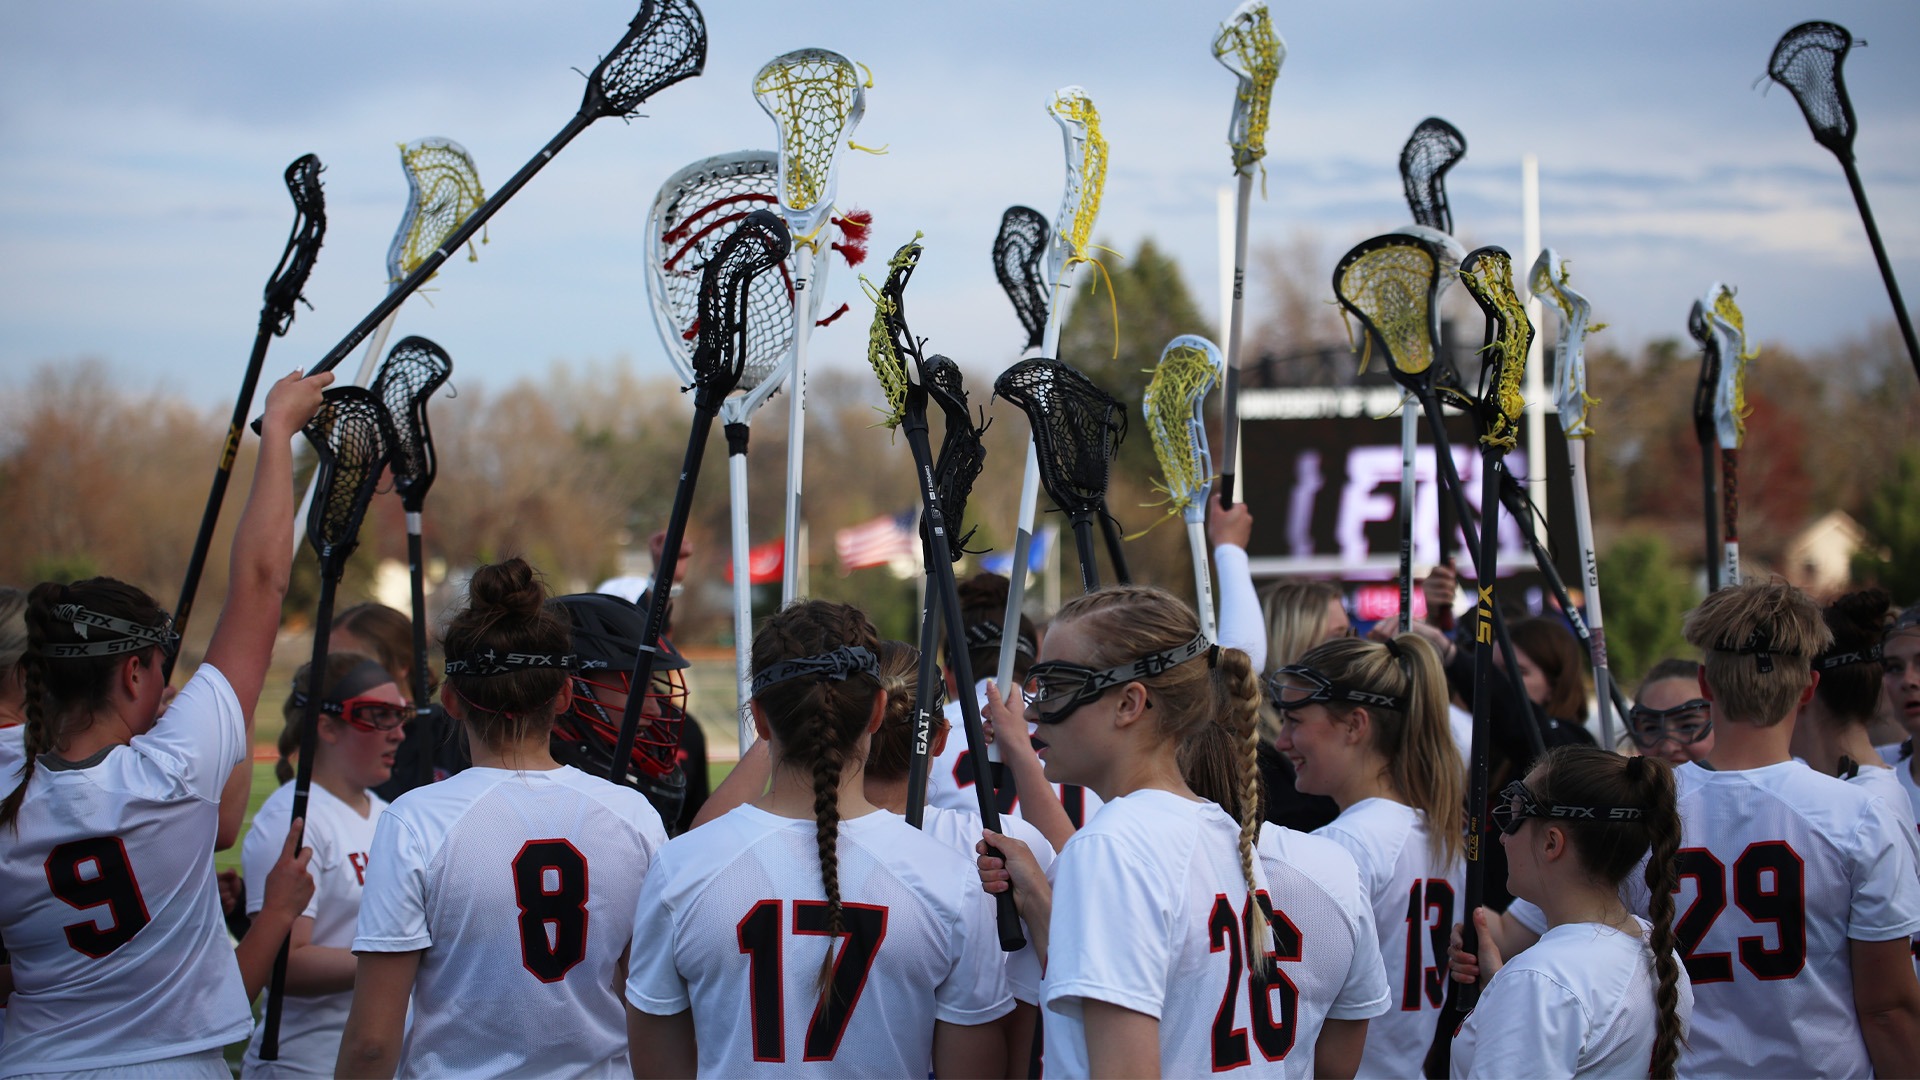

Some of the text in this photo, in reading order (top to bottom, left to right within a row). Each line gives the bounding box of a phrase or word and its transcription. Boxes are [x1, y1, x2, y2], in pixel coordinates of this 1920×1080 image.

[1586, 548, 1598, 588] GAIT
[74, 610, 112, 629] STX
[128, 623, 162, 641] STX
[1476, 583, 1494, 647] STX
[55, 636, 142, 657] STX STX
[446, 660, 469, 673] STX
[505, 652, 553, 666] STX
[1824, 651, 1862, 669] STX
[1346, 689, 1395, 708] STX
[915, 708, 931, 756] GAIT
[1550, 805, 1596, 819] STX
[43, 835, 152, 960] 9
[511, 837, 590, 984] 8
[1670, 840, 1807, 985] 29
[1401, 878, 1455, 1011] 13
[736, 898, 889, 1063] 17
